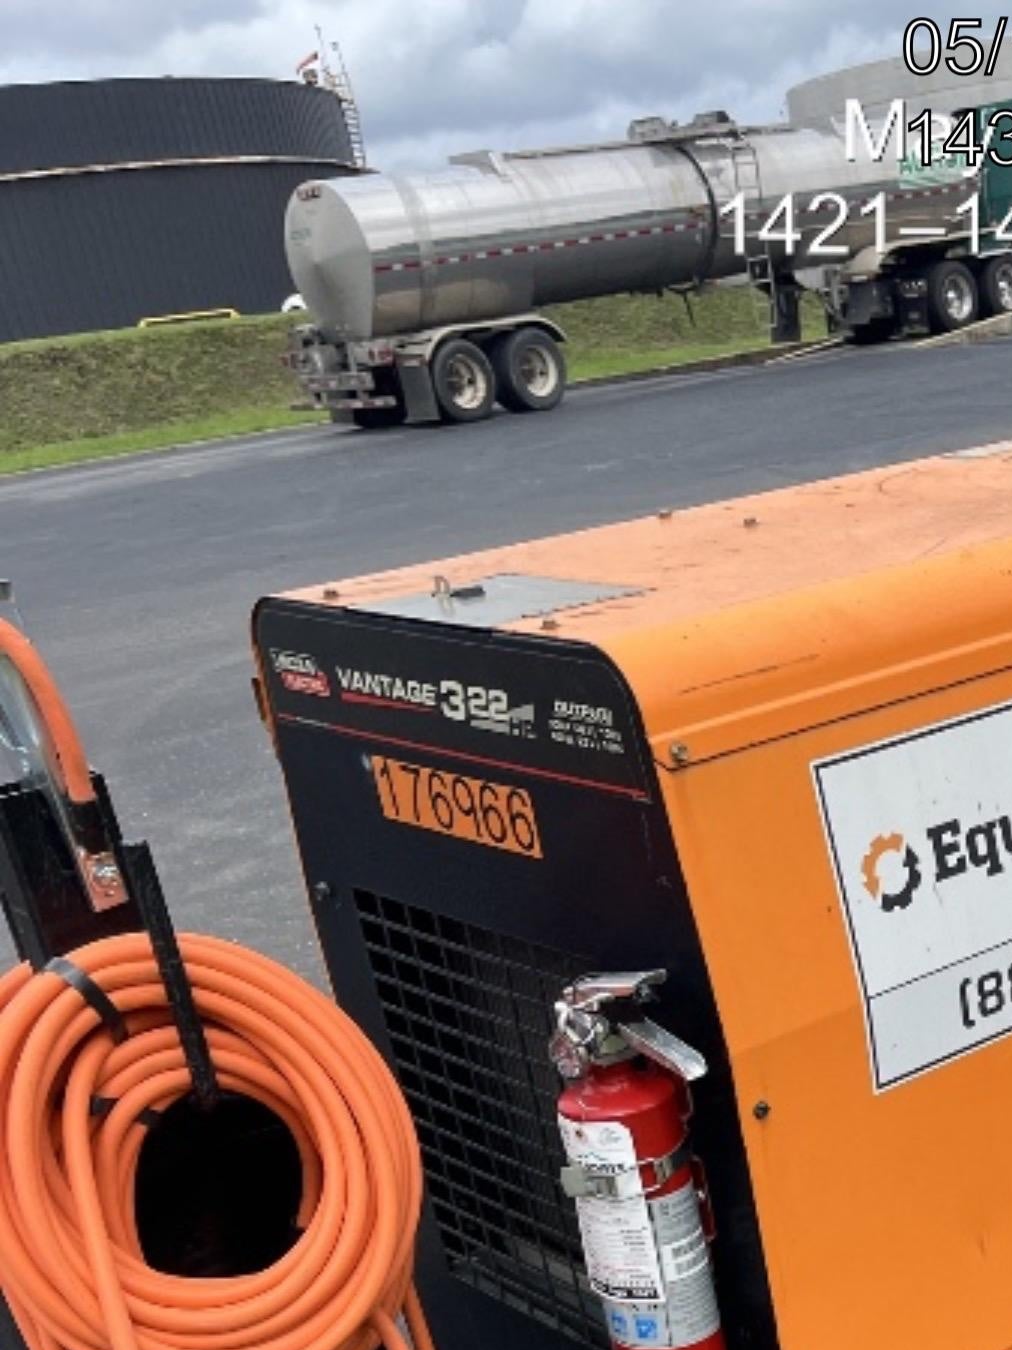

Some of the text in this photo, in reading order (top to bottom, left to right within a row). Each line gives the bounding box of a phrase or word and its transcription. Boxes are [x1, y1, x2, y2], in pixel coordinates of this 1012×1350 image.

[336, 666, 438, 706] VANTAGE
[440, 679, 510, 722] 322
[378, 765, 536, 851] 176966
